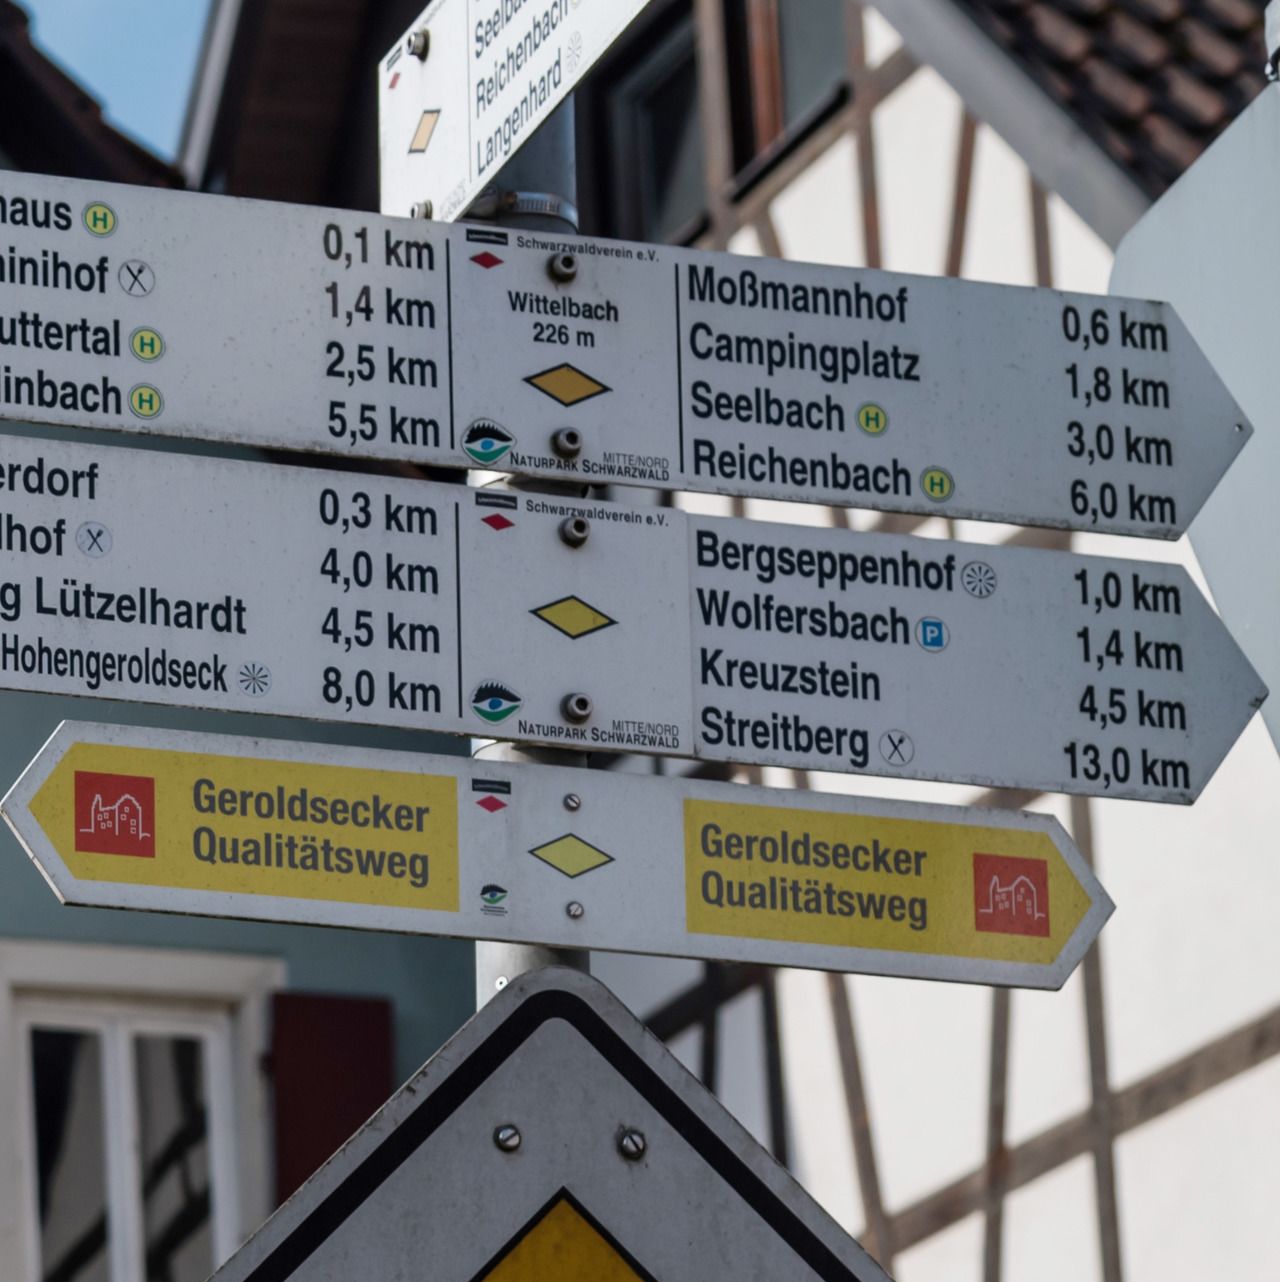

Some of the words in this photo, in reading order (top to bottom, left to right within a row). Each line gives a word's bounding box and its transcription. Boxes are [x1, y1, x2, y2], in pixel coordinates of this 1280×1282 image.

[476, 0, 568, 118] Reichenbach
[477, 47, 562, 176] Langenhard
[322, 223, 370, 270] 0,1
[385, 230, 434, 270] km
[517, 236, 632, 258] Schwarzwaldverein
[637, 250, 660, 262] e.V.
[326, 282, 373, 327] 1,4
[386, 288, 435, 328] km
[508, 291, 618, 322] Wittelbach
[689, 265, 907, 323] Moßmannhof
[533, 322, 569, 344] 226
[577, 331, 594, 347] m
[1063, 306, 1109, 350] 0,6
[1120, 312, 1167, 351] km
[326, 341, 375, 386] 2,5
[388, 347, 437, 387] km
[690, 322, 920, 384] Campingplatz
[692, 381, 844, 432] Seelbach
[1066, 364, 1111, 407] 1,8
[1123, 369, 1169, 408] km
[329, 401, 377, 446] 5,5
[390, 406, 439, 447] km
[1068, 421, 1113, 465] 3,0
[1125, 427, 1172, 466] km
[510, 452, 578, 472] NATURPARK
[583, 459, 669, 481] SCHWARZWALD
[603, 452, 669, 469] MITTE/NORD
[694, 439, 911, 496] Reichenbach
[320, 489, 371, 533] 0,3
[385, 494, 437, 535] km
[526, 500, 641, 523] Schwarzwaldverein
[646, 515, 669, 526] e.V.
[1071, 480, 1117, 524] 6,0
[1129, 484, 1176, 524] km
[321, 548, 372, 592] 4,0
[387, 553, 438, 594] km
[697, 530, 955, 591] Bergseppenhof
[36, 577, 246, 634] Lützelhardt
[1075, 569, 1121, 613] 1,0
[1133, 574, 1181, 615] km
[322, 607, 373, 652] 4,5
[388, 612, 439, 653] km
[697, 588, 909, 644] Wolfersbach
[2, 633, 227, 692] Hohengeroldseck
[1077, 627, 1123, 671] 1,4
[1135, 632, 1183, 672] km
[323, 667, 374, 712] 8,0
[389, 672, 440, 712] km
[701, 648, 880, 700] Kreuzstein
[612, 720, 678, 736] MITTE/NORD
[1080, 685, 1126, 729] 4,5
[1138, 690, 1186, 730] km
[518, 720, 587, 740] NATURPARK
[591, 728, 679, 749] SCHWARZWALD
[702, 707, 868, 768] Streitberg
[1064, 742, 1130, 789] 13,0
[1142, 749, 1190, 789] km
[194, 779, 429, 832] Geroldsecker
[193, 827, 428, 888] Qualitätsweg
[701, 824, 927, 876] Geroldsecker
[702, 871, 927, 931] Qualitätsweg
